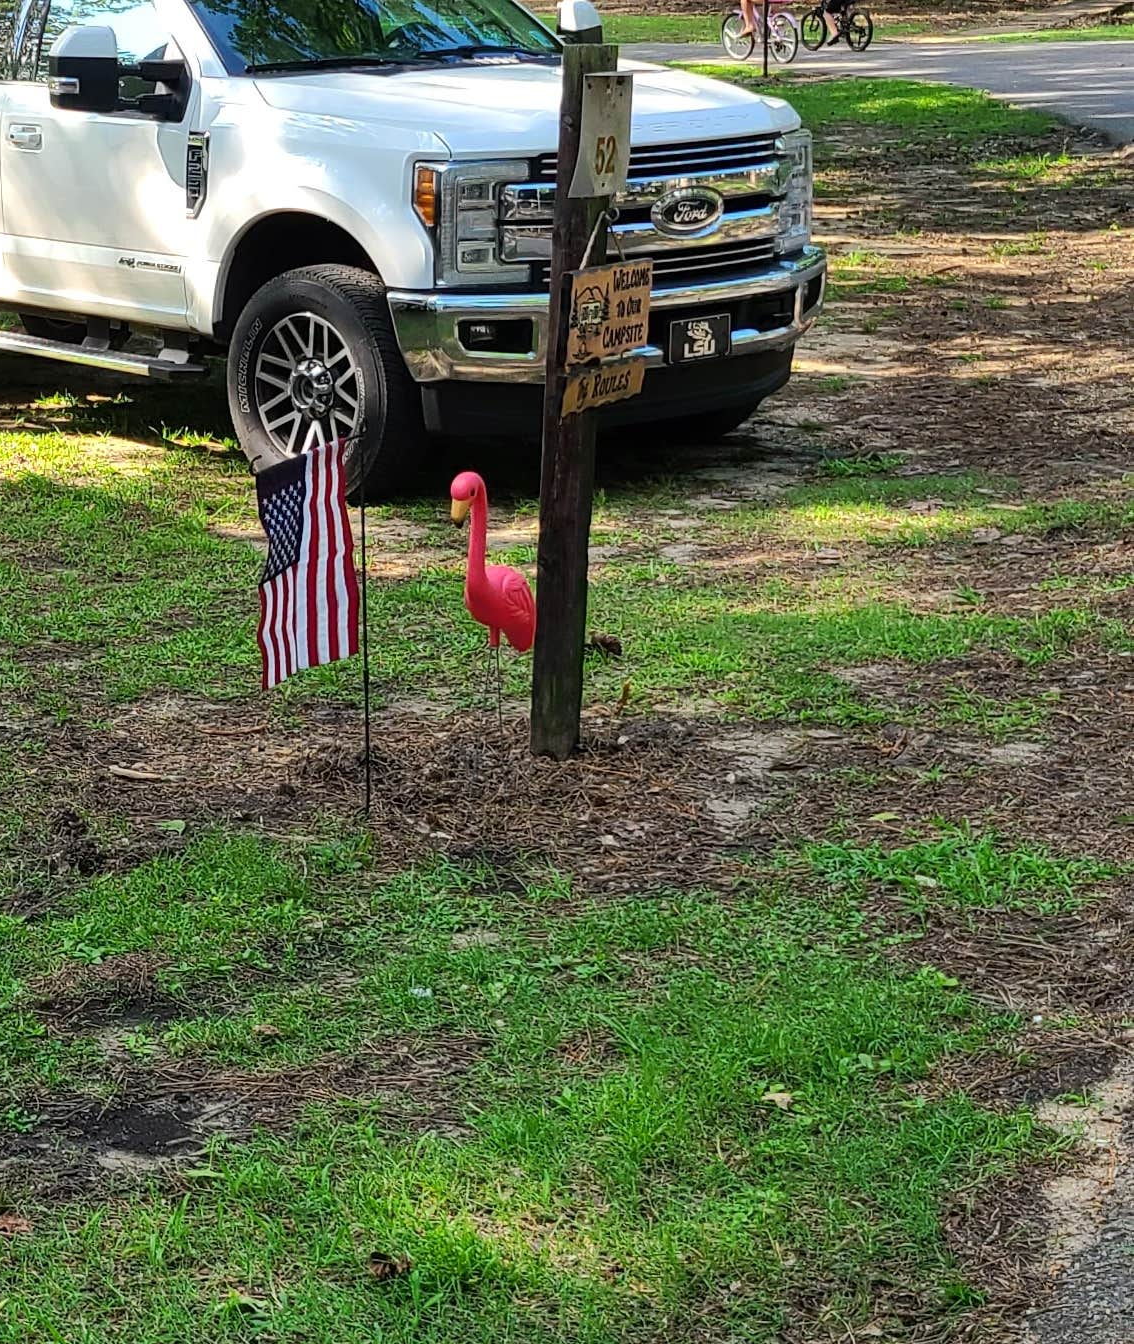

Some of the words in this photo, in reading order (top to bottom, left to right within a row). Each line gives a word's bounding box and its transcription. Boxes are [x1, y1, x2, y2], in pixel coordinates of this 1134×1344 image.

[595, 135, 616, 175] 52
[674, 201, 708, 223] Ford
[613, 268, 650, 292] WELCOME
[602, 323, 644, 349] CAMPSITE
[683, 338, 715, 359] LSU
[237, 317, 262, 413] MICHELIN
